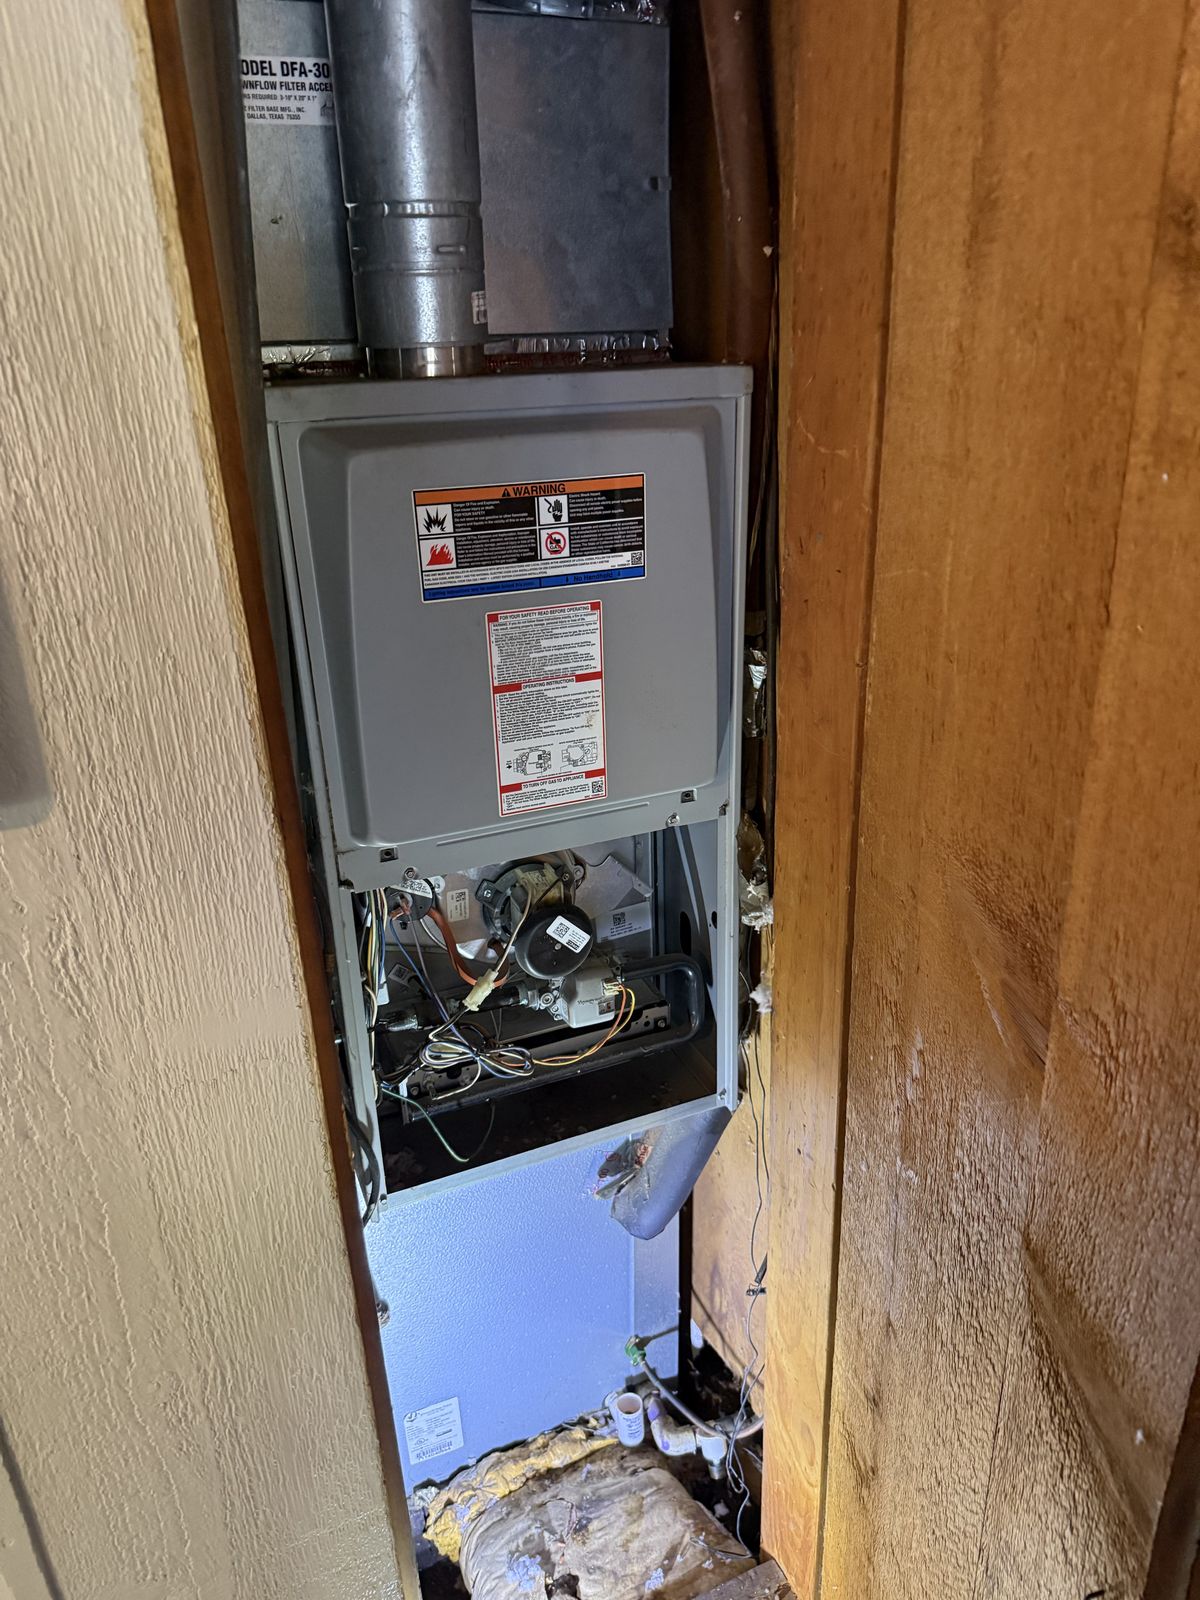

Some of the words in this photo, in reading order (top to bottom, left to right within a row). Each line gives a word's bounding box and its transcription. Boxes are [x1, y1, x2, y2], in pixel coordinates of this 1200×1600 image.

[241, 60, 276, 76] ODEL
[242, 80, 277, 90] WNFLOW
[280, 82, 306, 92] FILTER
[309, 82, 333, 92] ACCE
[512, 483, 565, 496] WARNING
[583, 571, 612, 580] Handhold
[546, 677, 574, 686] INSTRUCTIONS
